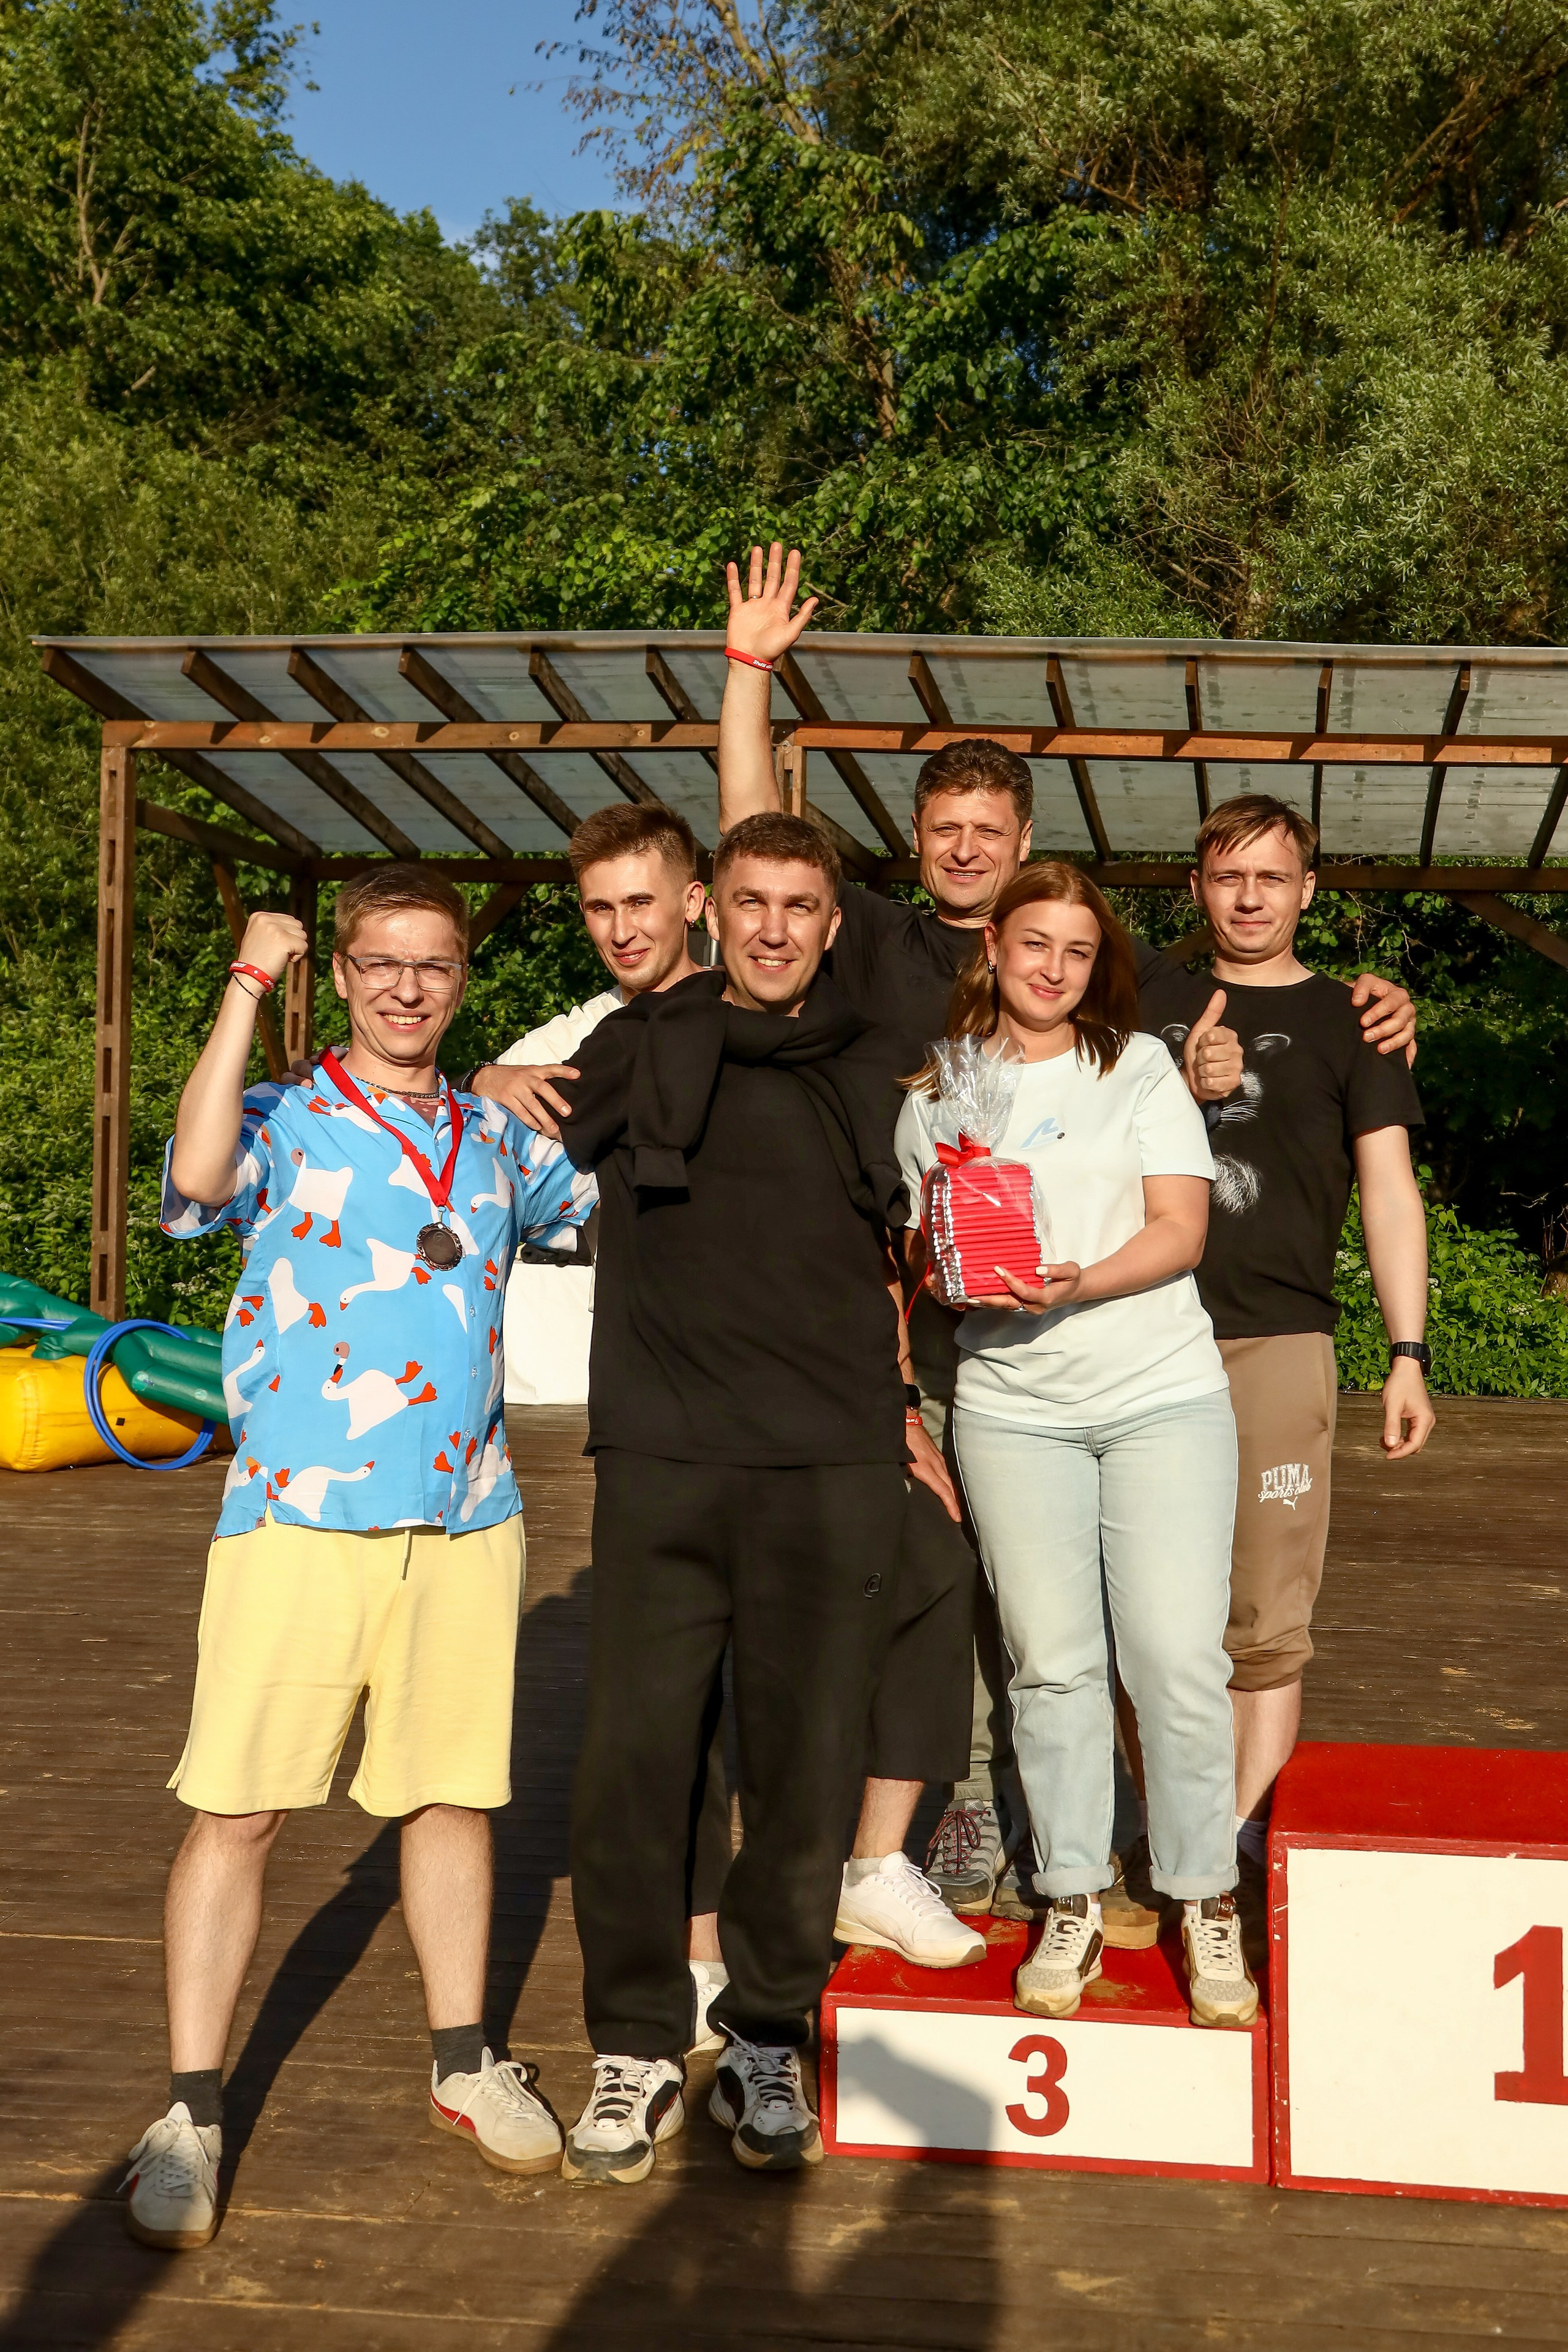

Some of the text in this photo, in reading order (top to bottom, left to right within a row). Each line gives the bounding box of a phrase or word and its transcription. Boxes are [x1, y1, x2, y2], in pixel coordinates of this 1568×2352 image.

[1257, 1477, 1313, 1503] sports club
[1261, 1463, 1310, 1492] PUMA
[1493, 1924, 1568, 2106] 1
[1005, 2034, 1069, 2137] 3
